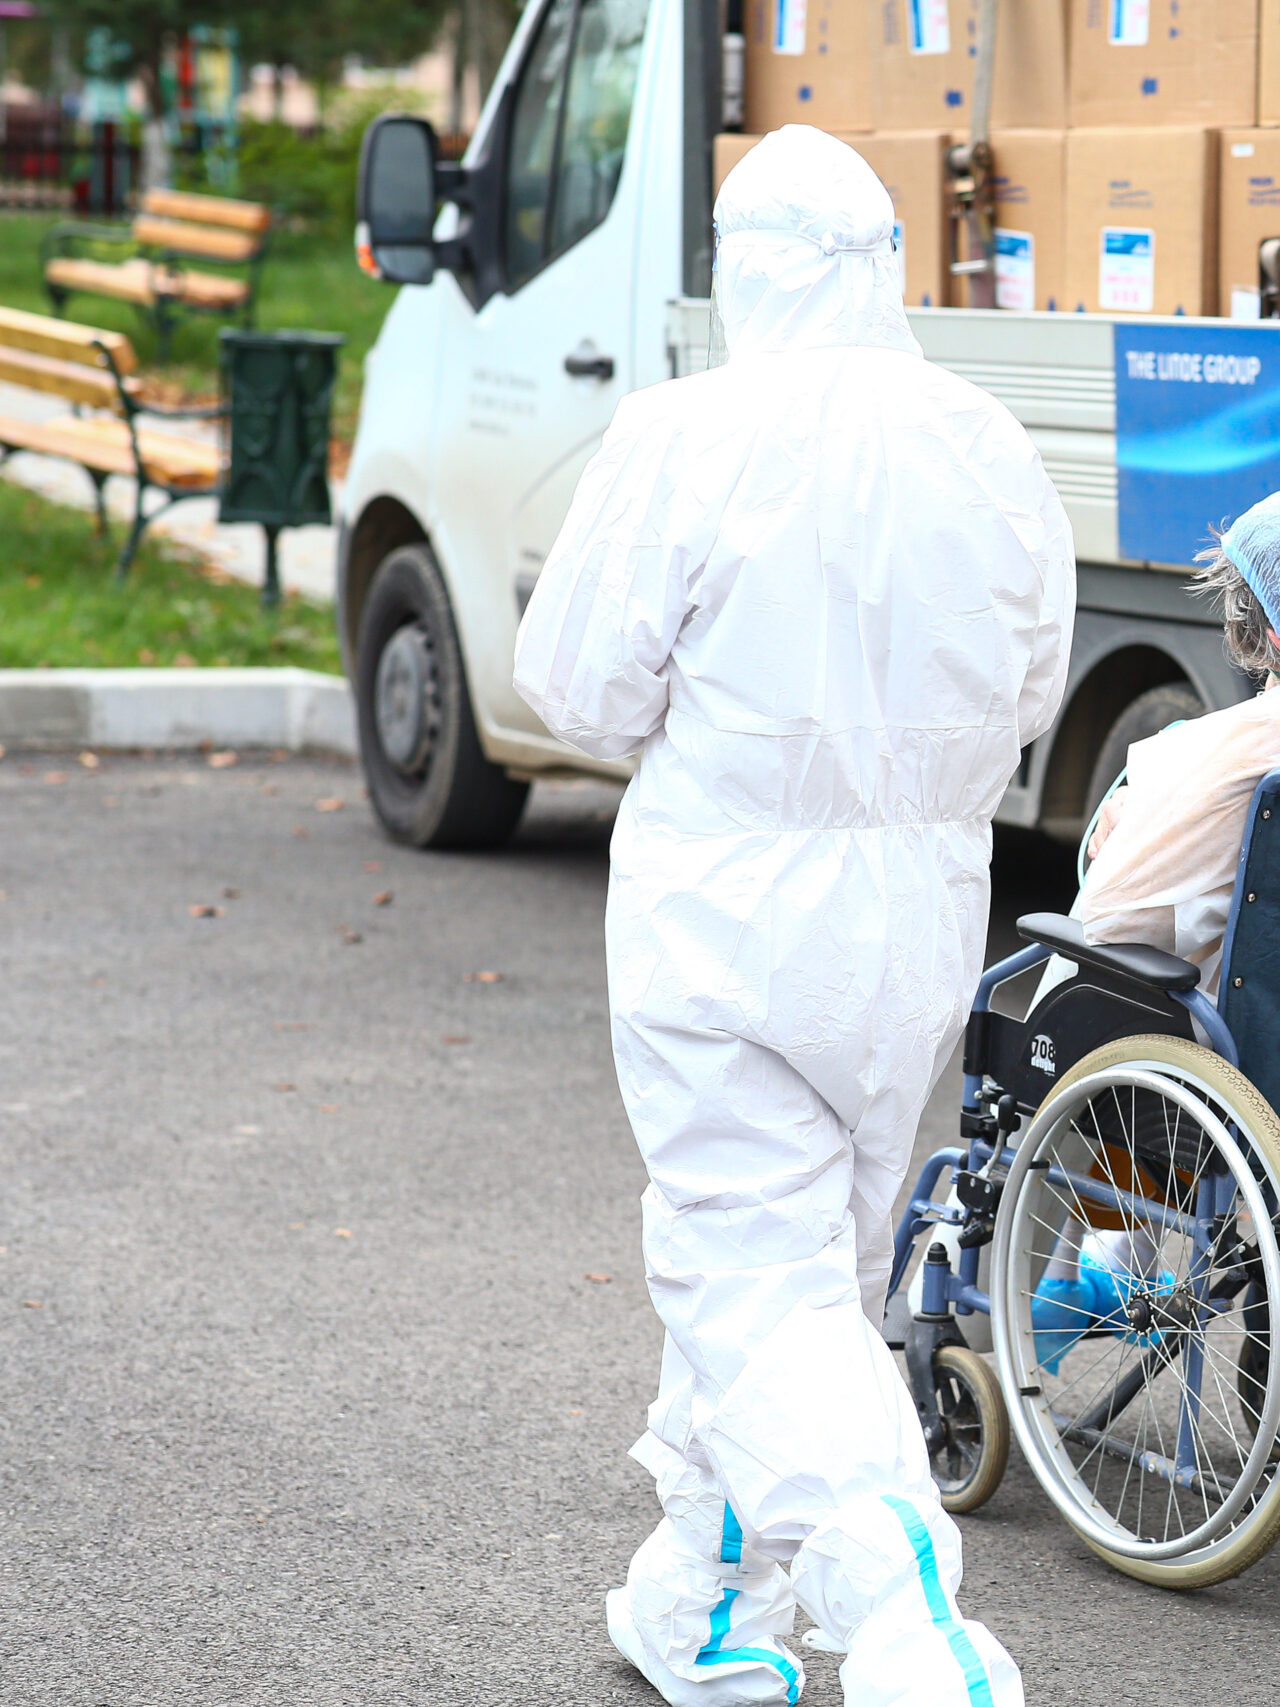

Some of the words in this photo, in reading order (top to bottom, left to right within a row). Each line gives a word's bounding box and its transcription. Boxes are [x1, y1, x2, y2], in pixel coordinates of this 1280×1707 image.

[1126, 351, 1156, 380] THE
[1157, 352, 1202, 382] LINDE
[1203, 354, 1260, 385] GROUP
[1030, 1038, 1056, 1062] 708
